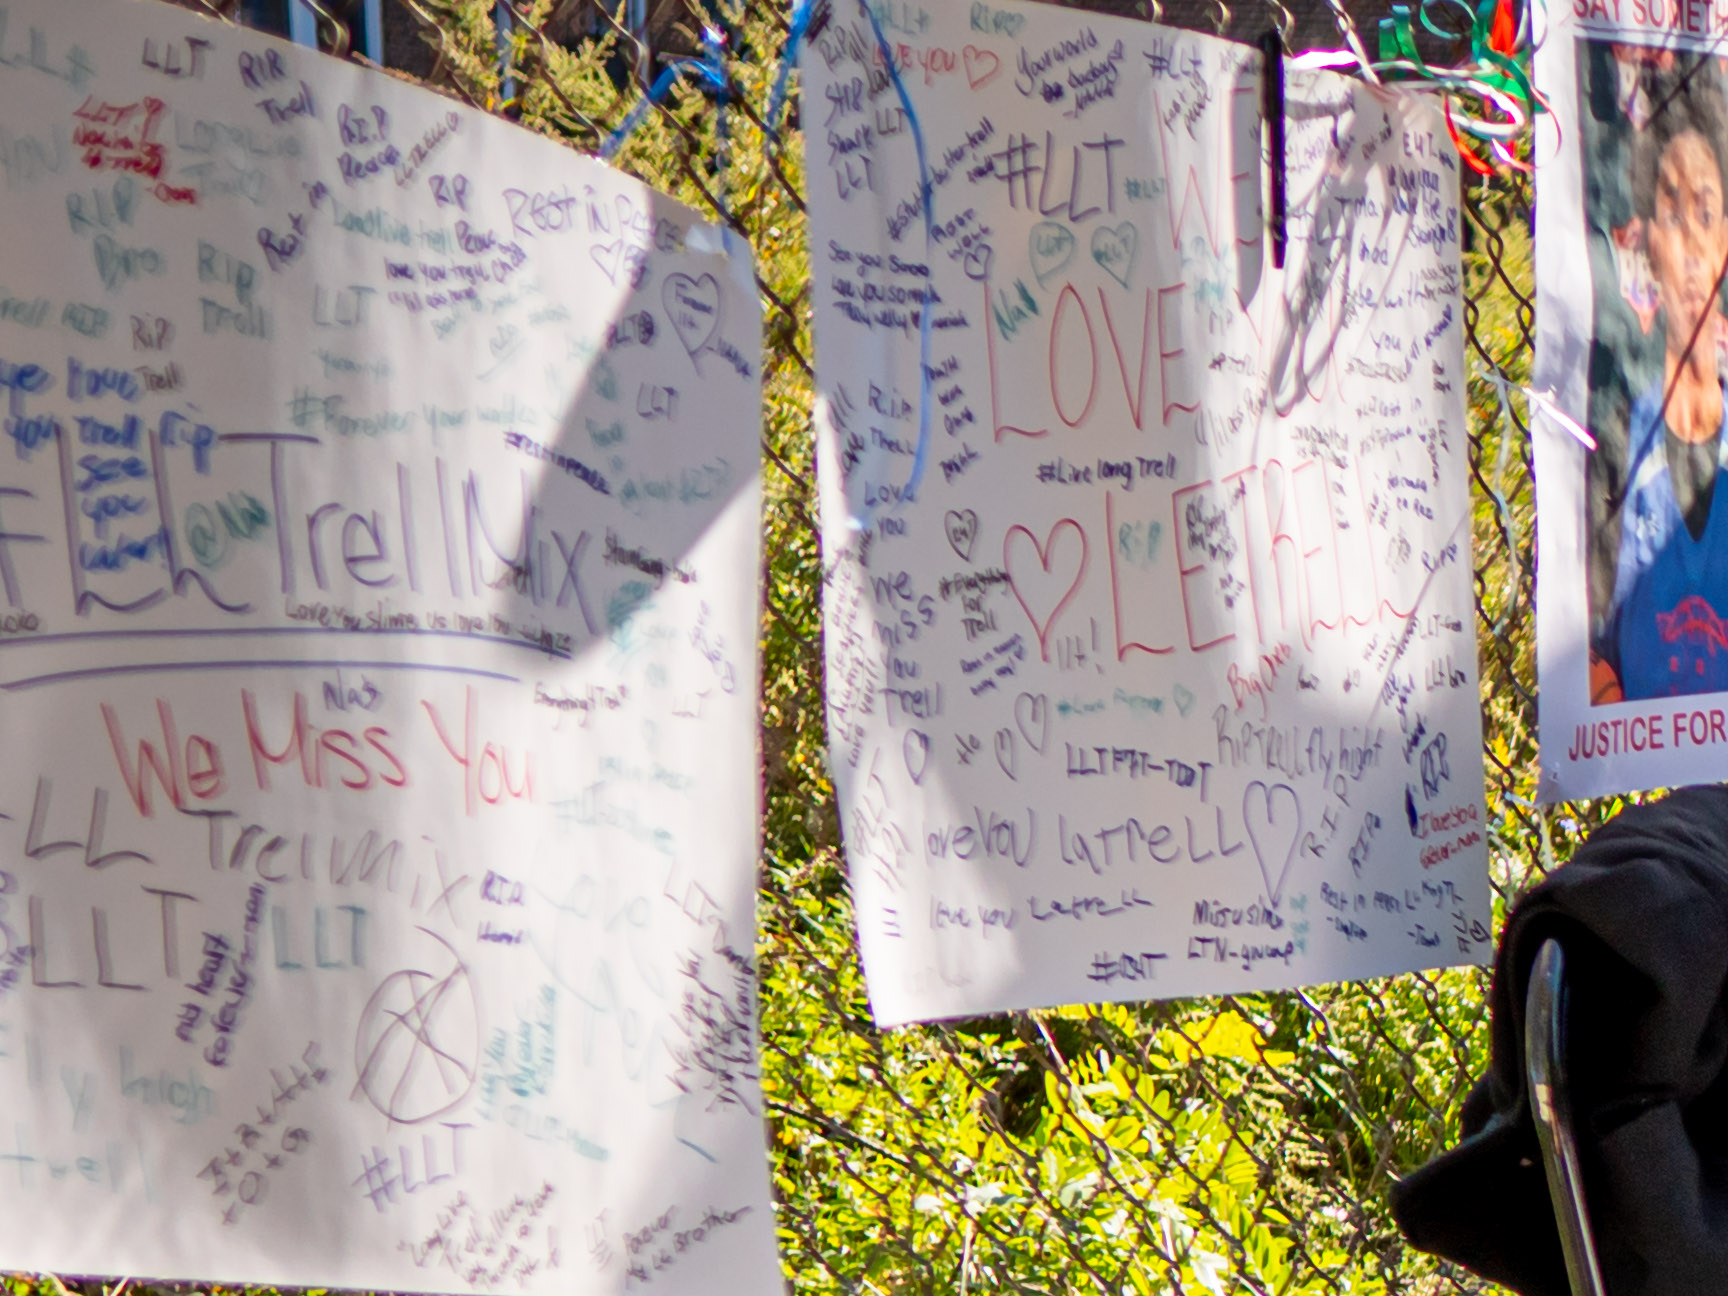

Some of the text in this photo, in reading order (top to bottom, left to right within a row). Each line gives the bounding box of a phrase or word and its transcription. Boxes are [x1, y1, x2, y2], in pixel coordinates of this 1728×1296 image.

[142, 37, 214, 78] LLT
[990, 129, 1126, 223] #LLT
[983, 281, 1201, 443] LOVE
[102, 683, 536, 818] We Miss You
[1568, 715, 1665, 763] JUSTICE
[1672, 709, 1728, 749] FOR
[28, 884, 200, 992] LLT
[271, 904, 369, 970] LLT
